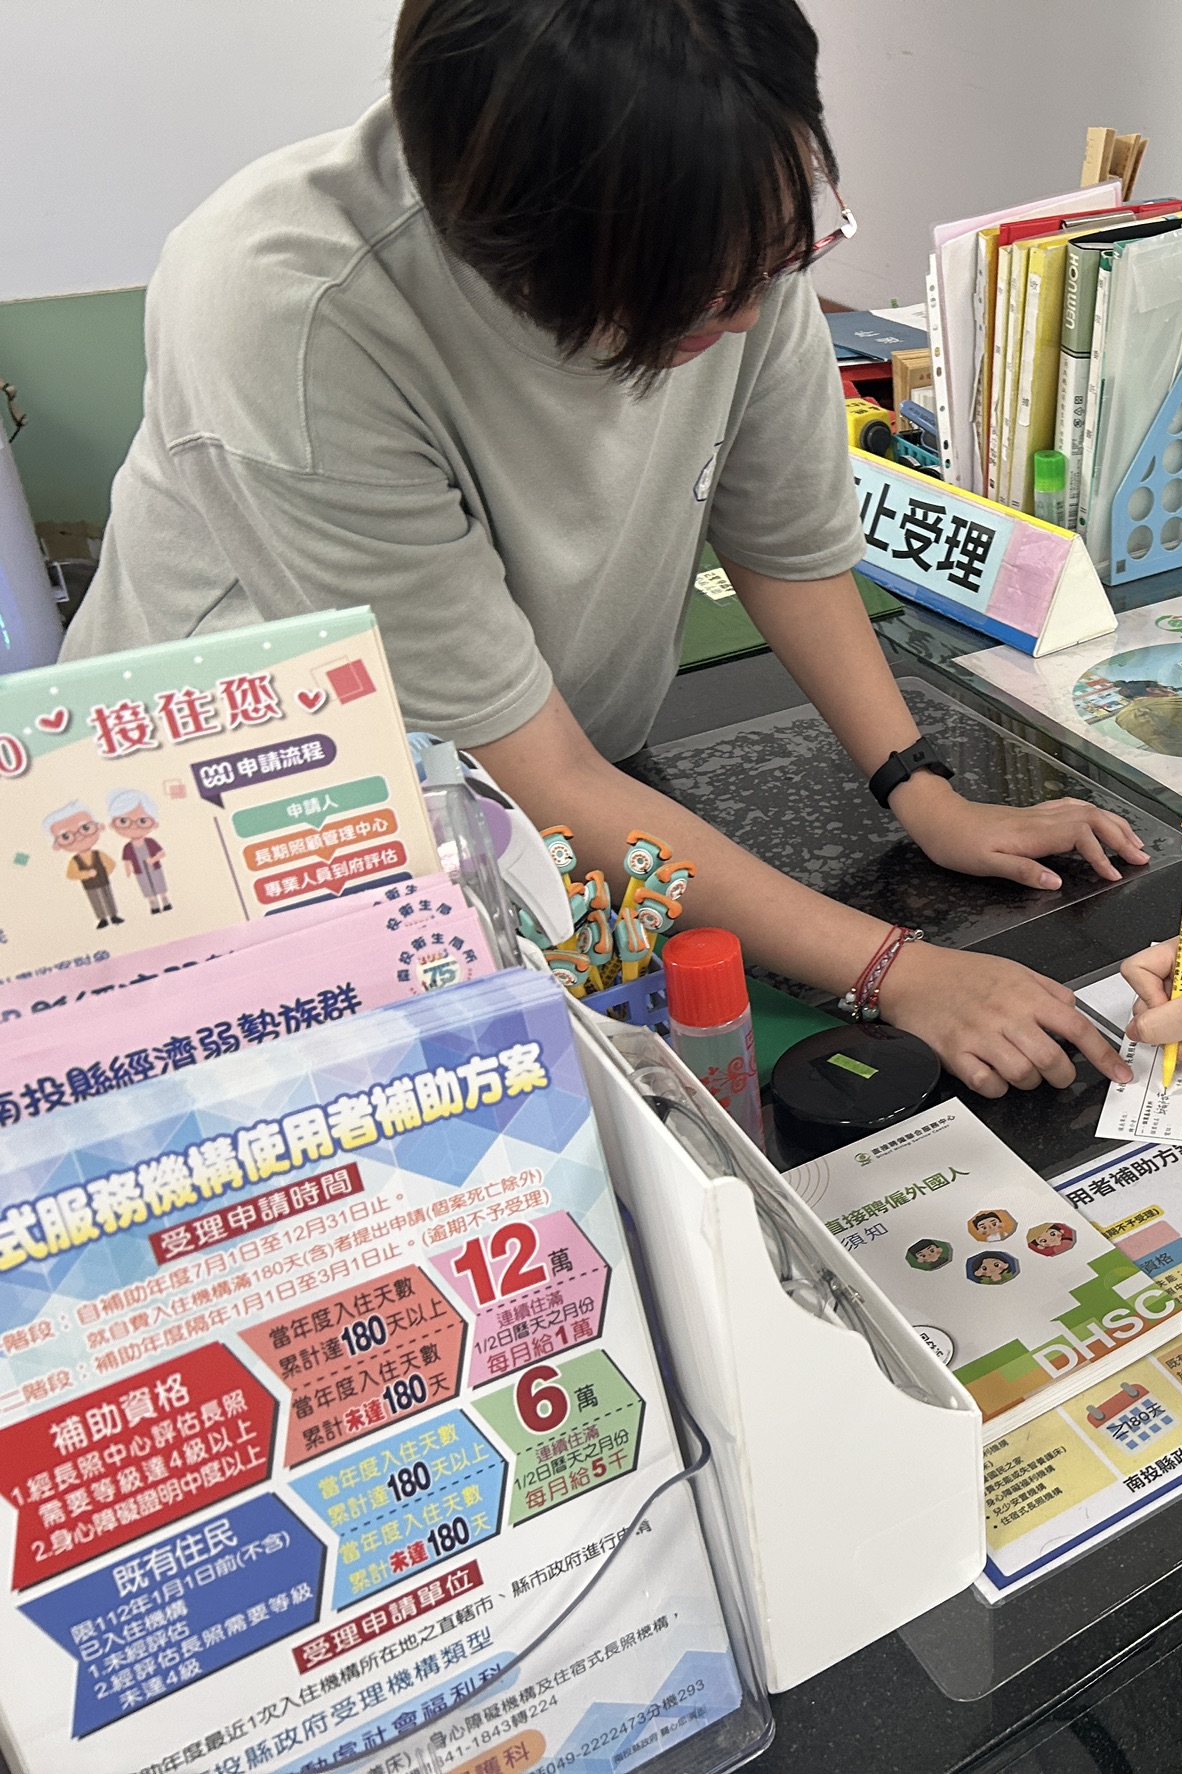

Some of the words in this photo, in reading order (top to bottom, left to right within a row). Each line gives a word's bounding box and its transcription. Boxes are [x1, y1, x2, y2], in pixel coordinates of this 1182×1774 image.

[854, 476, 996, 594] 止受理
[91, 673, 282, 756] 接住您
[237, 741, 326, 780] 申請流程
[254, 816, 389, 865] 長期照顧管理中心
[286, 793, 339, 818] 申請人
[263, 848, 399, 898] 專業人員到府評估
[0, 981, 363, 1127] 南投縣經濟弱勢族群
[0, 1041, 549, 1271] 式服務機構使用者補助方案
[160, 1168, 353, 1259] 受理申請時間
[824, 1166, 970, 1235] 直接聘僱外國人
[268, 1276, 417, 1350] 當年度入住天數
[278, 1297, 448, 1380] 累計達180天以上
[473, 1295, 595, 1356] 1/2日曆天之月份
[486, 1317, 594, 1376] 每月給1萬
[495, 1289, 565, 1328] 連續住滿
[1032, 1290, 1175, 1379] DHSC
[49, 1372, 191, 1456] 補助資格
[292, 1342, 442, 1422] 當年度入住天數
[302, 1371, 451, 1451] 累計未達180天
[38, 1418, 258, 1530] 需要等級達4級以上
[317, 1423, 460, 1501] 當年度入住天數
[513, 1427, 630, 1492] 1/2日曆天之月份
[524, 1448, 629, 1511] 每月給5千
[534, 1423, 601, 1465] 連續住滿
[31, 1445, 266, 1562] 2.身心障礙證明中度以上
[326, 1441, 490, 1529] 累計達180天以上
[338, 1484, 484, 1565] 當年度入住天數
[70, 1530, 291, 1644] 限112年1月1日前(不含)
[112, 1517, 239, 1599] 既有住民
[348, 1511, 492, 1595] 累計未達180天
[79, 1599, 189, 1663] 已入住機構
[87, 1621, 191, 1680] 1.未經評估
[93, 1581, 315, 1700] 2.經評估長照需要等級
[301, 1567, 474, 1669] 受理申請單位
[119, 1656, 203, 1711] 未達4級
[200, 1626, 495, 1774] 投縣政府受理機構類型
